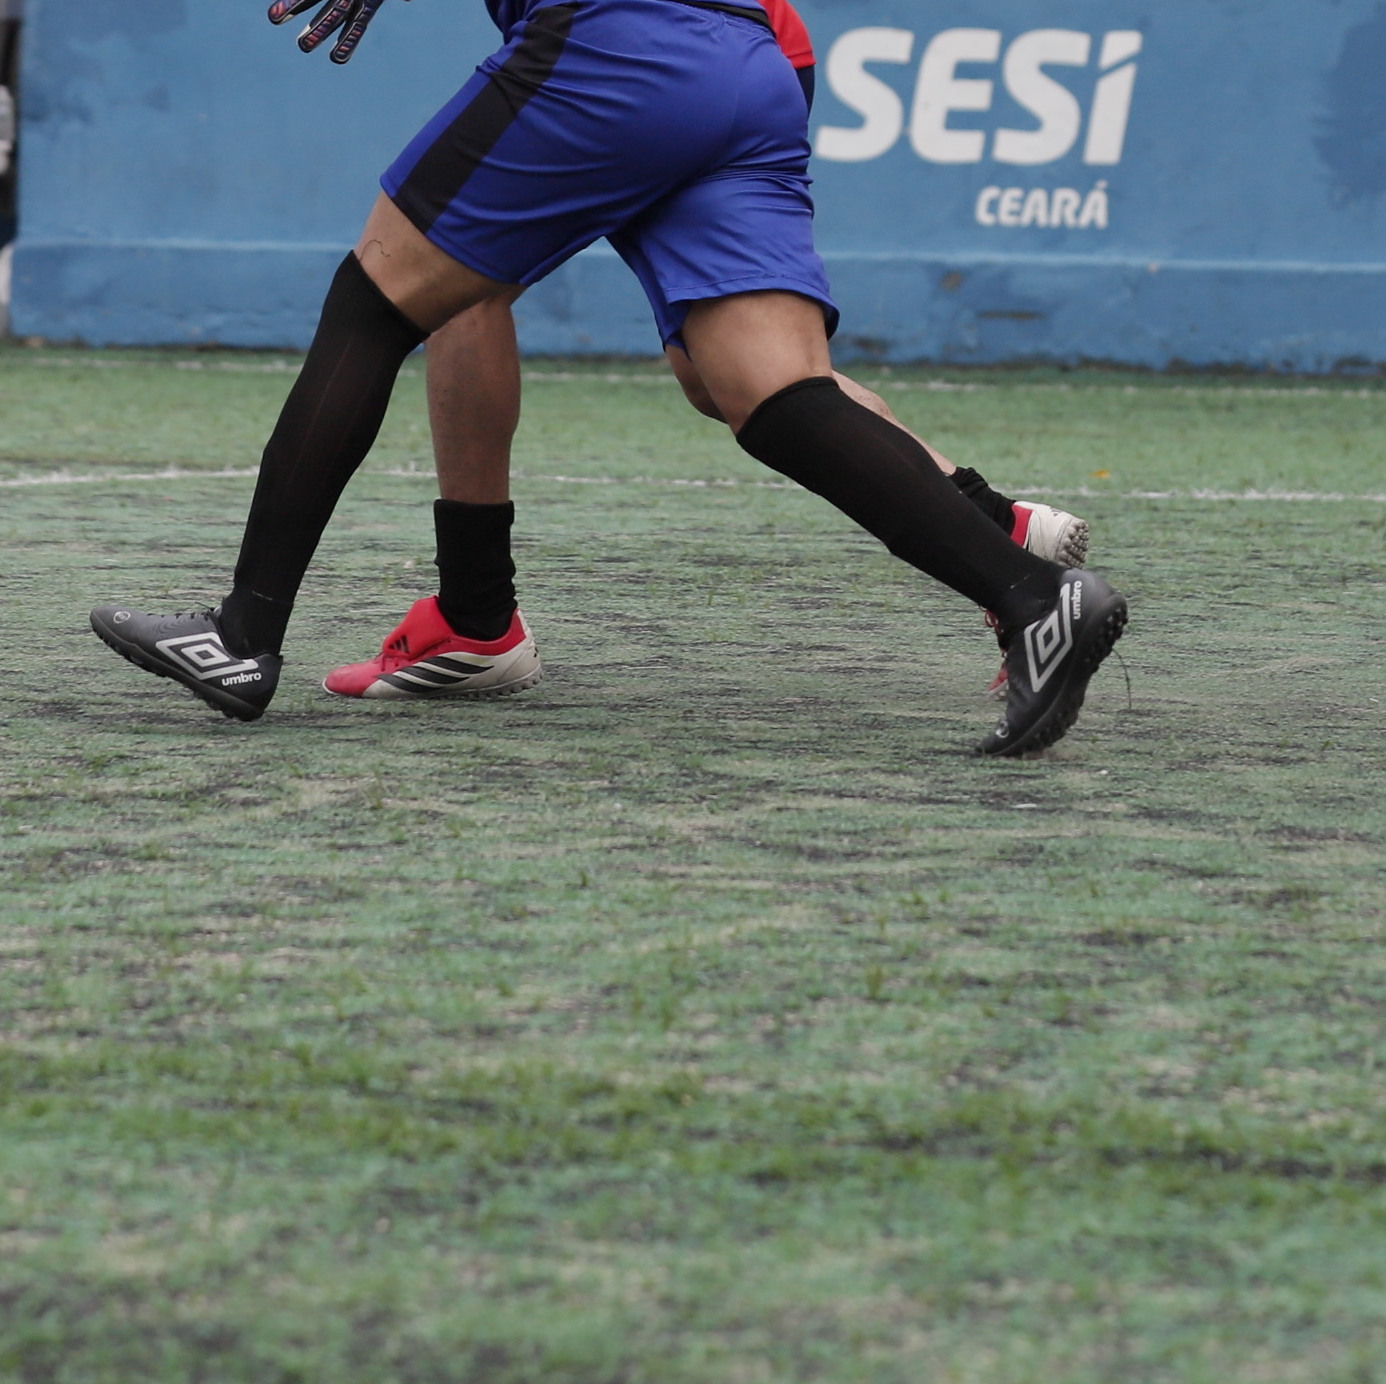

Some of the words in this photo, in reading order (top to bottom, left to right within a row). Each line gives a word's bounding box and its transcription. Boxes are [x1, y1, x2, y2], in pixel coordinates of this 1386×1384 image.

[975, 181, 1109, 229] CEARÁ
[1070, 580, 1083, 620] umbro
[221, 672, 262, 686] umbro
